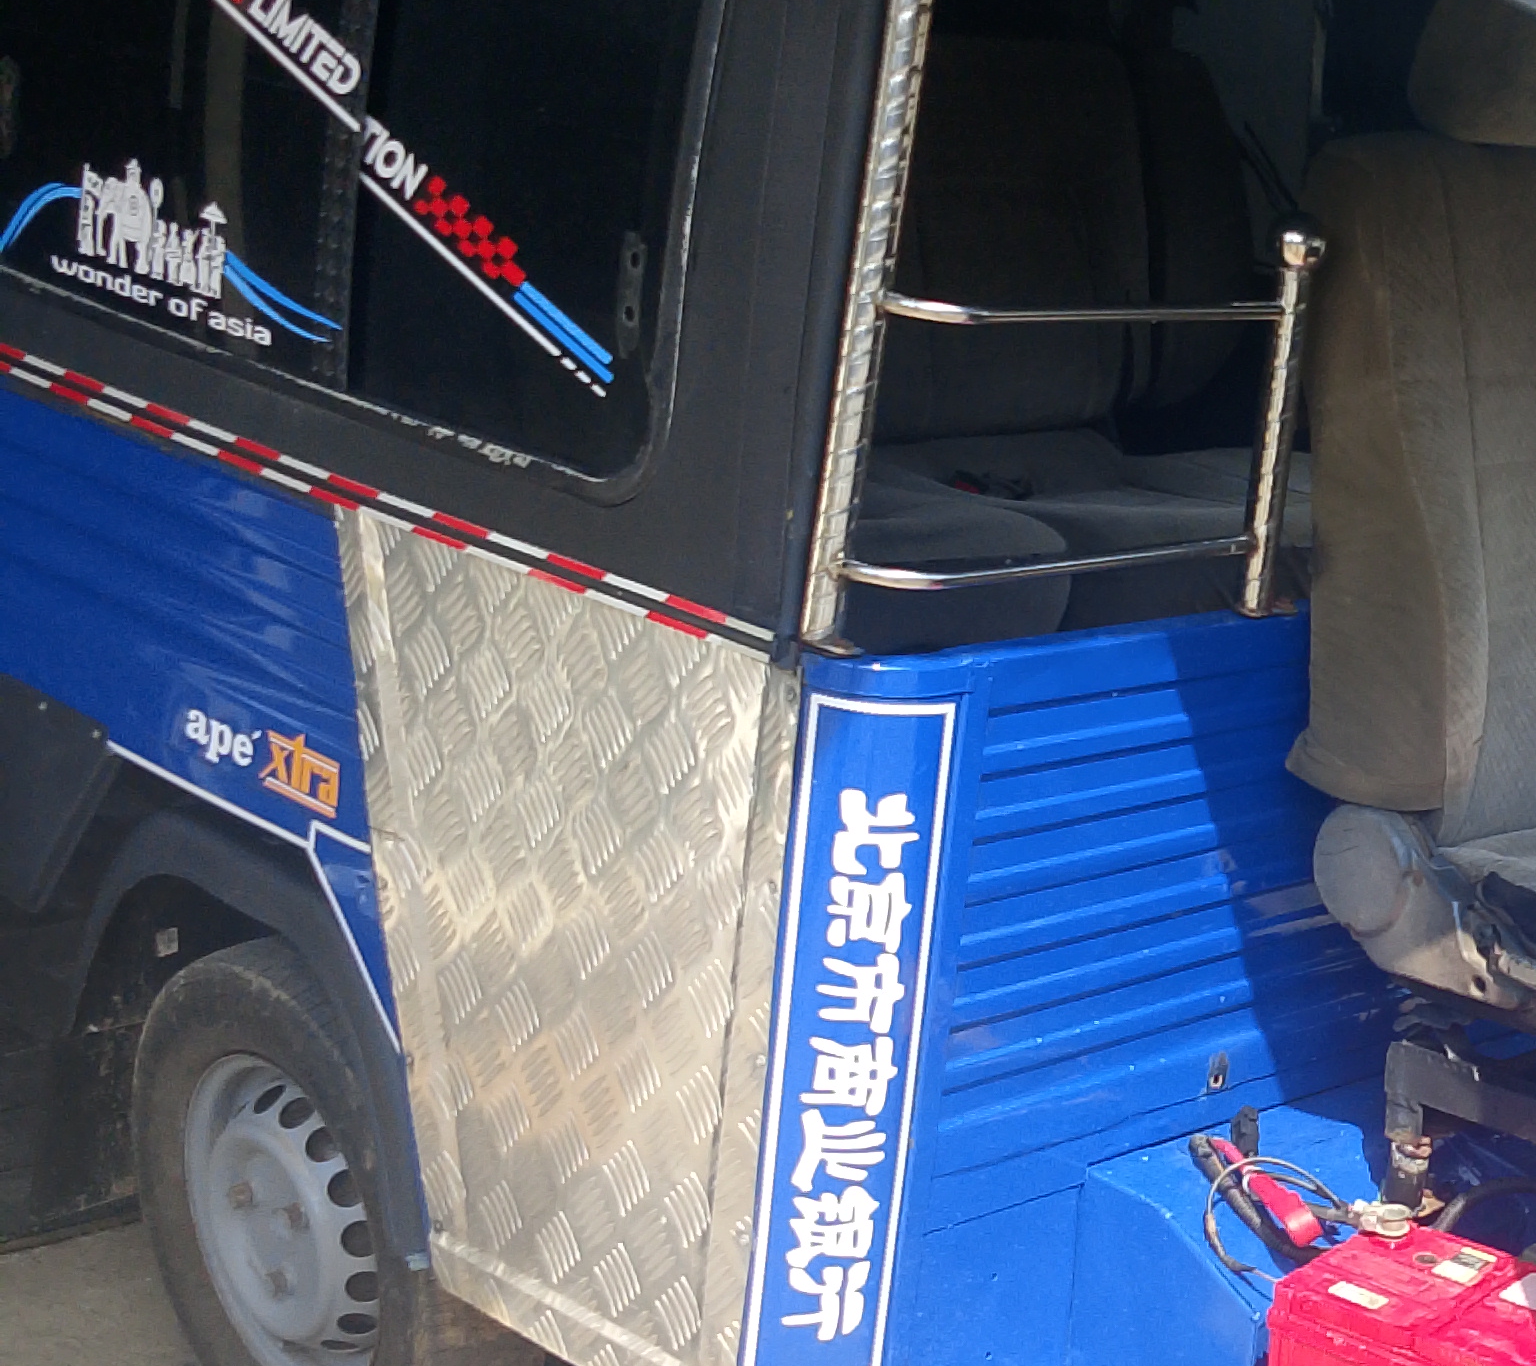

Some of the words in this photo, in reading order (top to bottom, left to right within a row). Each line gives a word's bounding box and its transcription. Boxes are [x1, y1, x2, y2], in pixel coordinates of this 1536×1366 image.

[50, 254, 164, 307] wonder
[167, 296, 208, 322] of
[207, 310, 273, 346] asia
[258, 730, 341, 813] xtra
[781, 788, 920, 1341] 北京市商业银行
